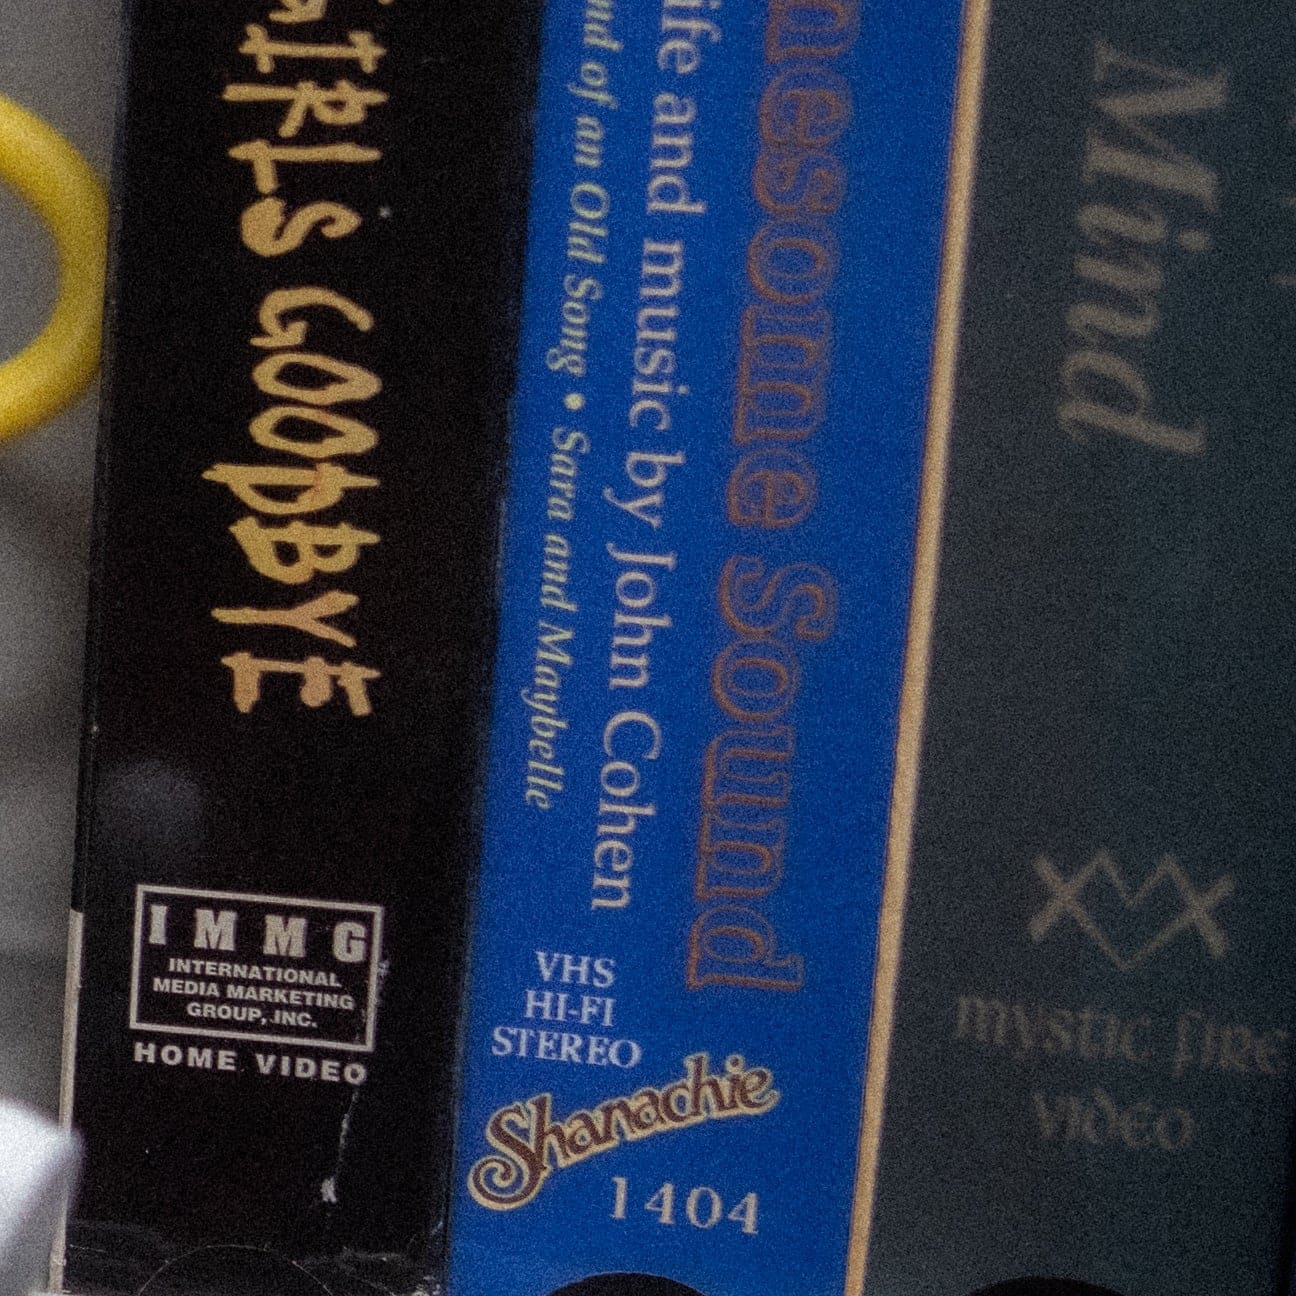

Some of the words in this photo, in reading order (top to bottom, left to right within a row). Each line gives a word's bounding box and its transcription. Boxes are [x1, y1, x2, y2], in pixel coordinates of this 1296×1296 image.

[567, 60, 620, 110] of
[573, 114, 607, 168] an
[646, 91, 706, 215] and
[567, 180, 610, 265] Old
[1057, 37, 1234, 458] Mind
[546, 274, 603, 378] Song
[628, 238, 690, 431] music
[201, 285, 383, 718] GOODBYE
[547, 424, 591, 522] Sara
[603, 450, 686, 529] by
[539, 534, 578, 613] and
[605, 542, 678, 691] John
[520, 620, 577, 811] Maybelle
[591, 710, 664, 910] Cohen
[685, 555, 840, 994] Sound
[151, 976, 221, 1000] MEDIA
[225, 983, 357, 1012] MARKETING
[167, 956, 344, 989] INTERNATIONAL
[523, 989, 617, 1027] HI-FI
[534, 950, 618, 988] VHS
[185, 1001, 269, 1026] GROUP,
[273, 1009, 319, 1030] INC.
[491, 1025, 643, 1069] STEREO
[132, 1041, 239, 1072] HOME
[255, 1051, 369, 1087] VIDEO
[467, 1052, 782, 1211] Shanachie
[610, 1175, 761, 1236] 1404
